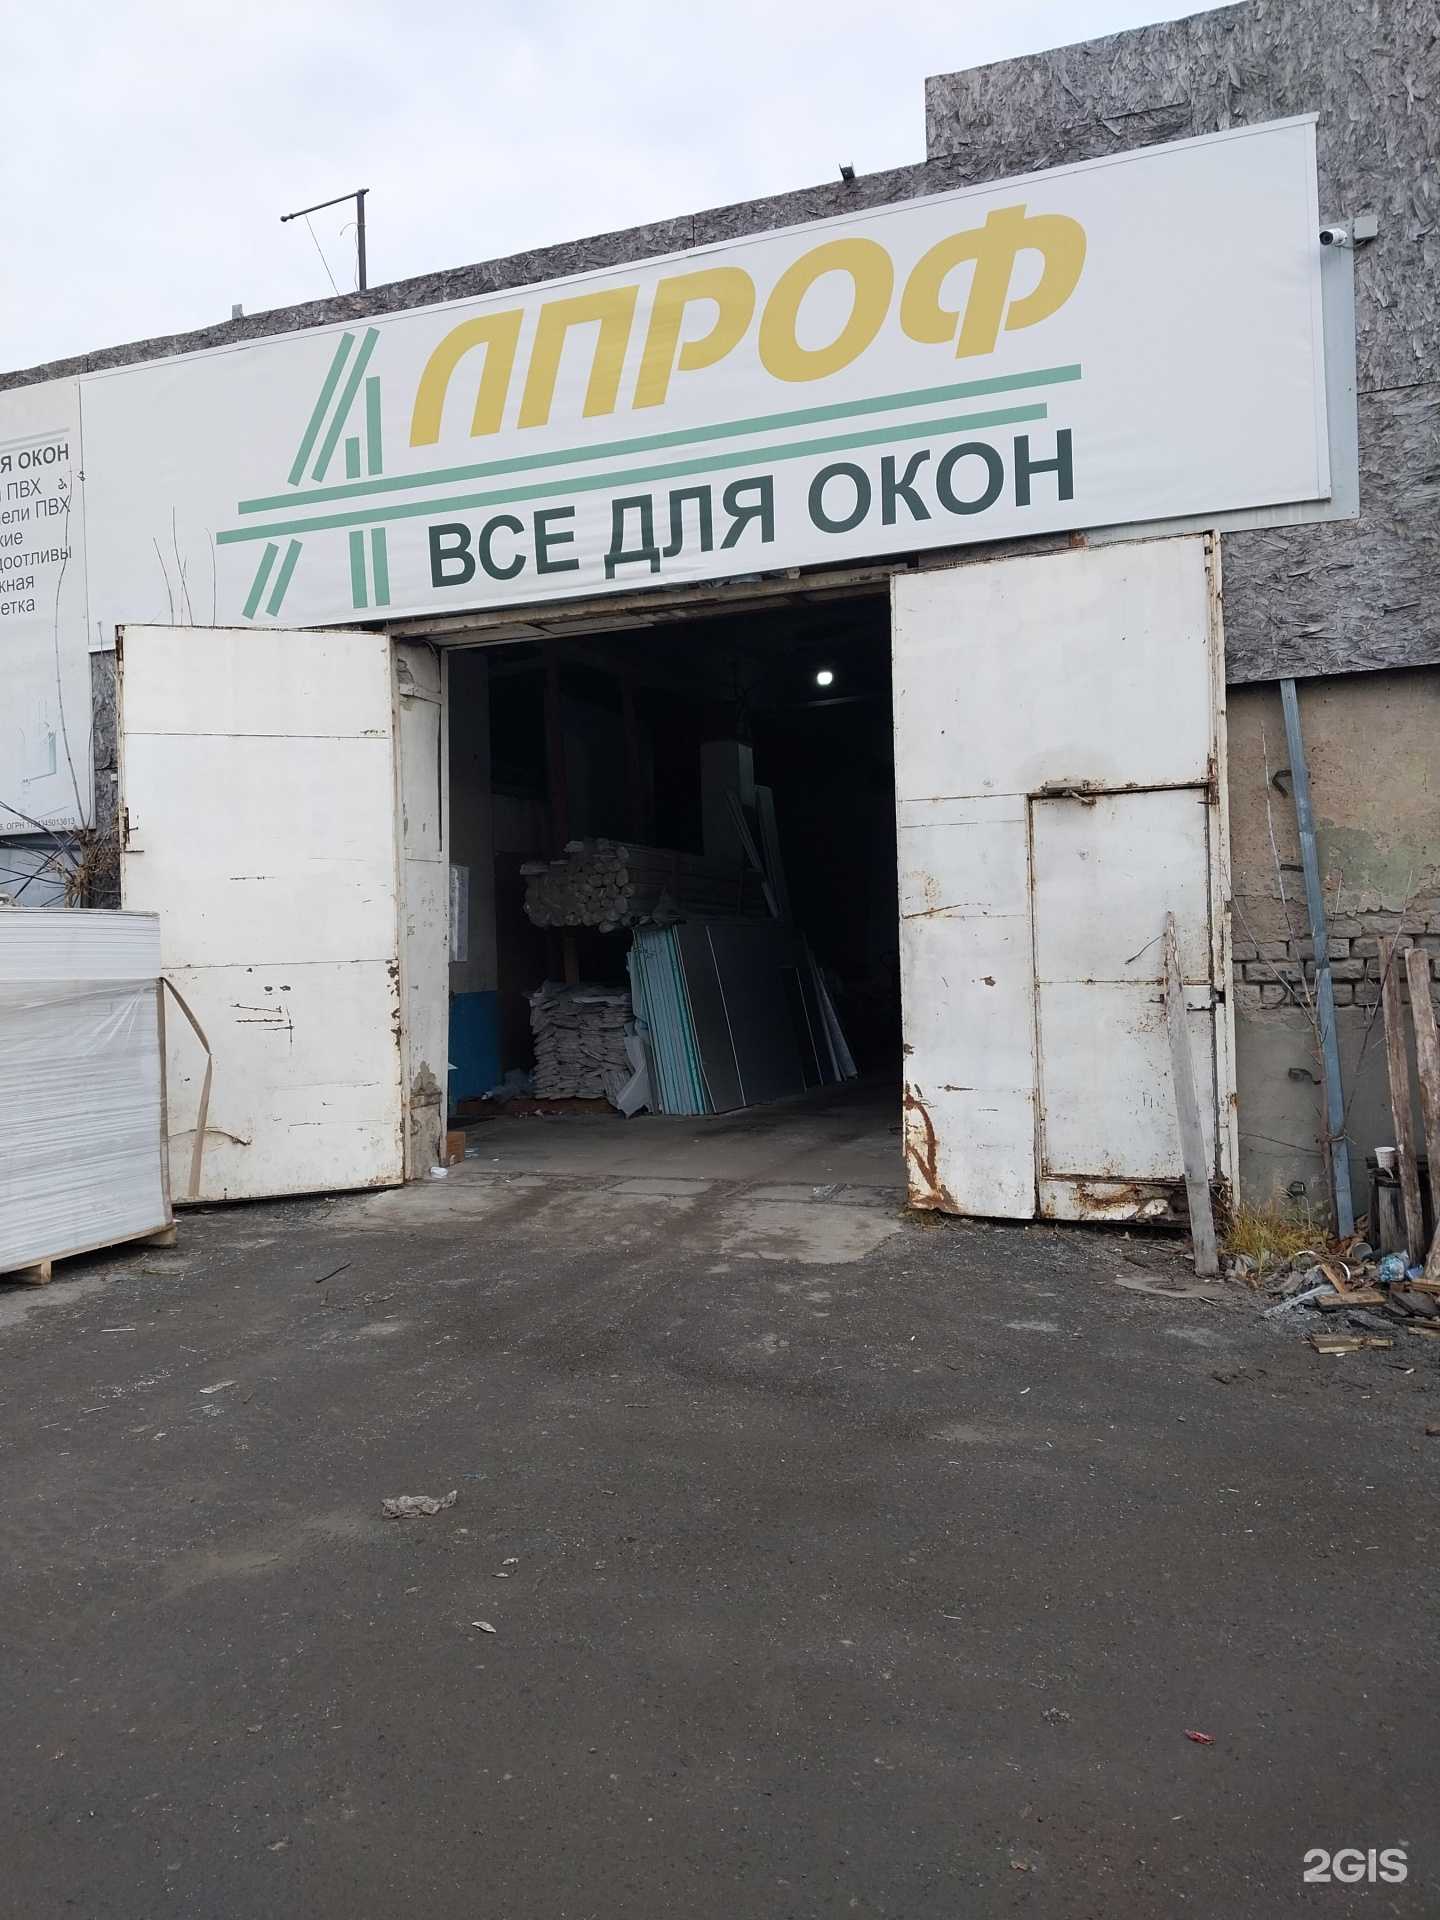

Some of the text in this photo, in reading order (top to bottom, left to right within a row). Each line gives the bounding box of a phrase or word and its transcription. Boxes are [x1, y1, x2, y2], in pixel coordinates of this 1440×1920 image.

[18, 443, 69, 469] ОКОН
[7, 478, 42, 500] ПВХ
[36, 495, 71, 518] ПВХ
[428, 429, 1076, 588] ВСЕ ДЛЯ ОКОН
[1, 598, 35, 616] етка
